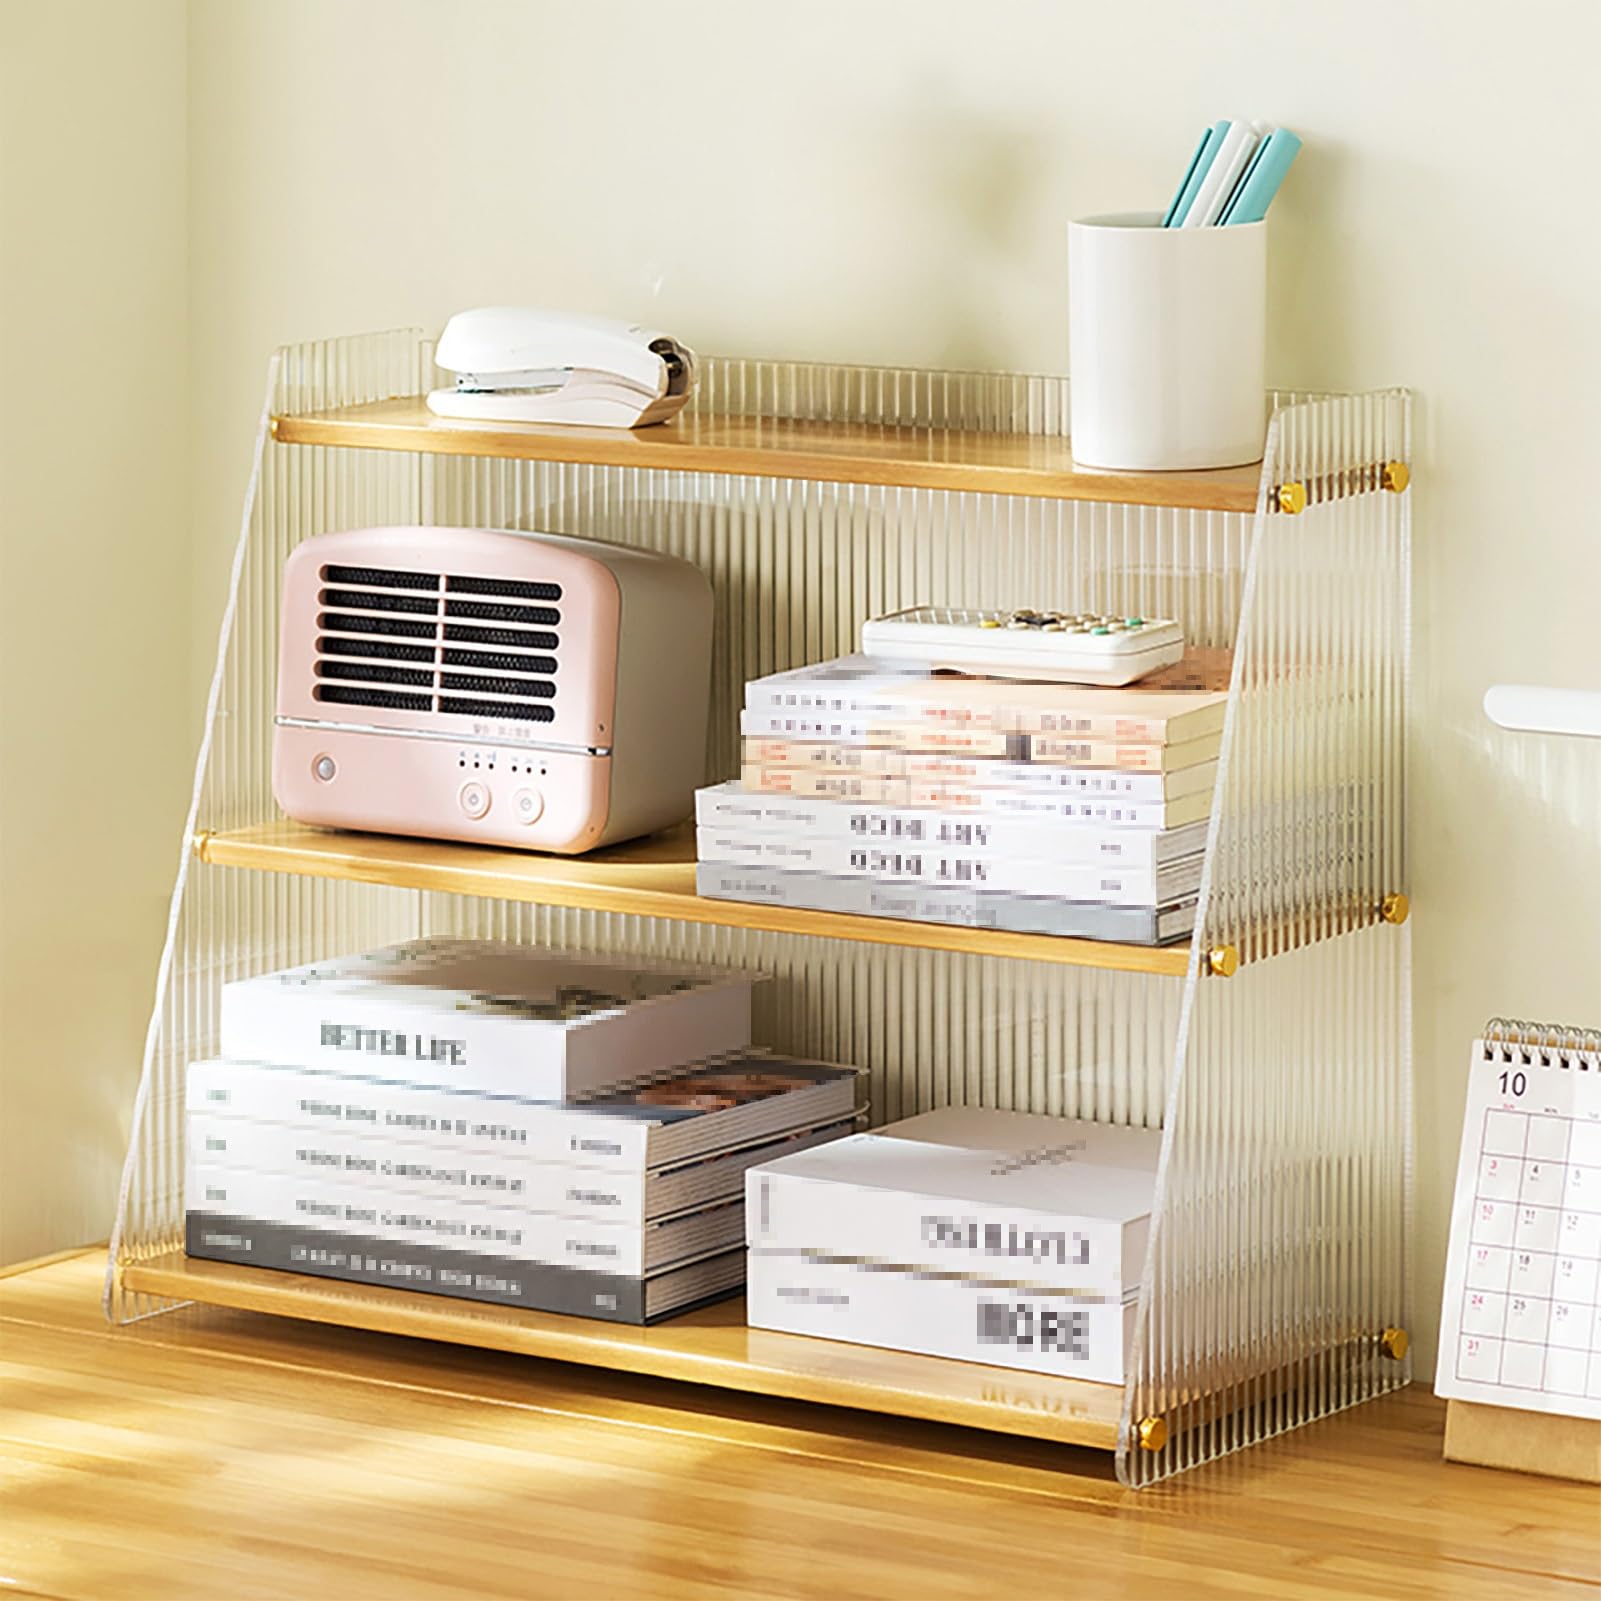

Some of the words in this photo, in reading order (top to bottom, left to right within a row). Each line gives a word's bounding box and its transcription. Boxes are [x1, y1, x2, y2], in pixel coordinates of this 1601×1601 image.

[416, 1034, 466, 1065] LIFE
[1499, 1071, 1526, 1096] 10
[1525, 1210, 1536, 1220] 11
[1477, 1250, 1489, 1261] 17
[1513, 1300, 1526, 1311] 25
